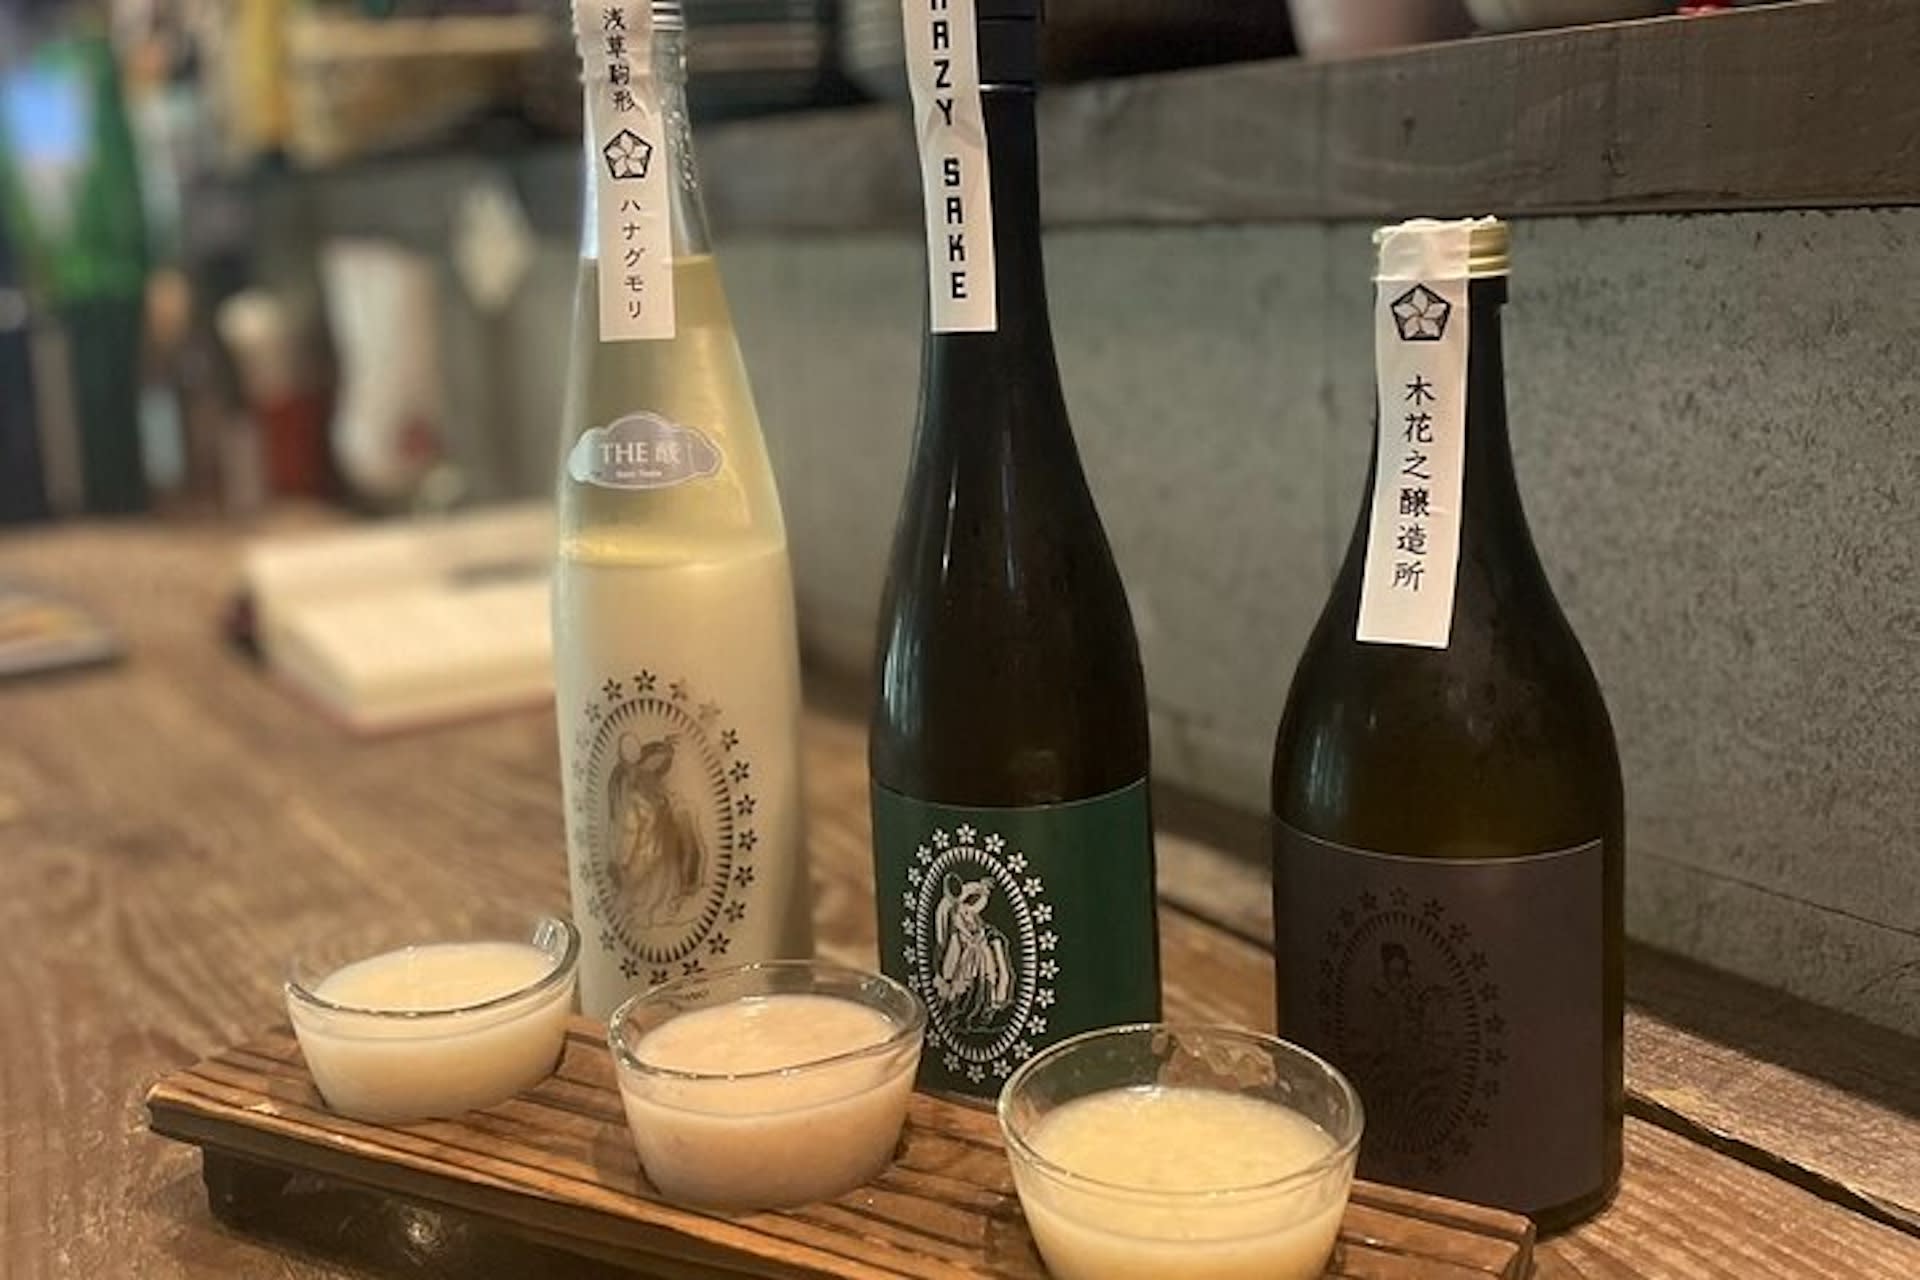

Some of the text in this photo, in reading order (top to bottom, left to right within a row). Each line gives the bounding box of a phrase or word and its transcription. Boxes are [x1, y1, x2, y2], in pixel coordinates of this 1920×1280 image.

[603, 8, 645, 318] 浅草駒形 ハナグモリ
[944, 158, 967, 299] SAKE
[600, 442, 649, 464] THE
[1393, 375, 1436, 591] 木花之醸造所
